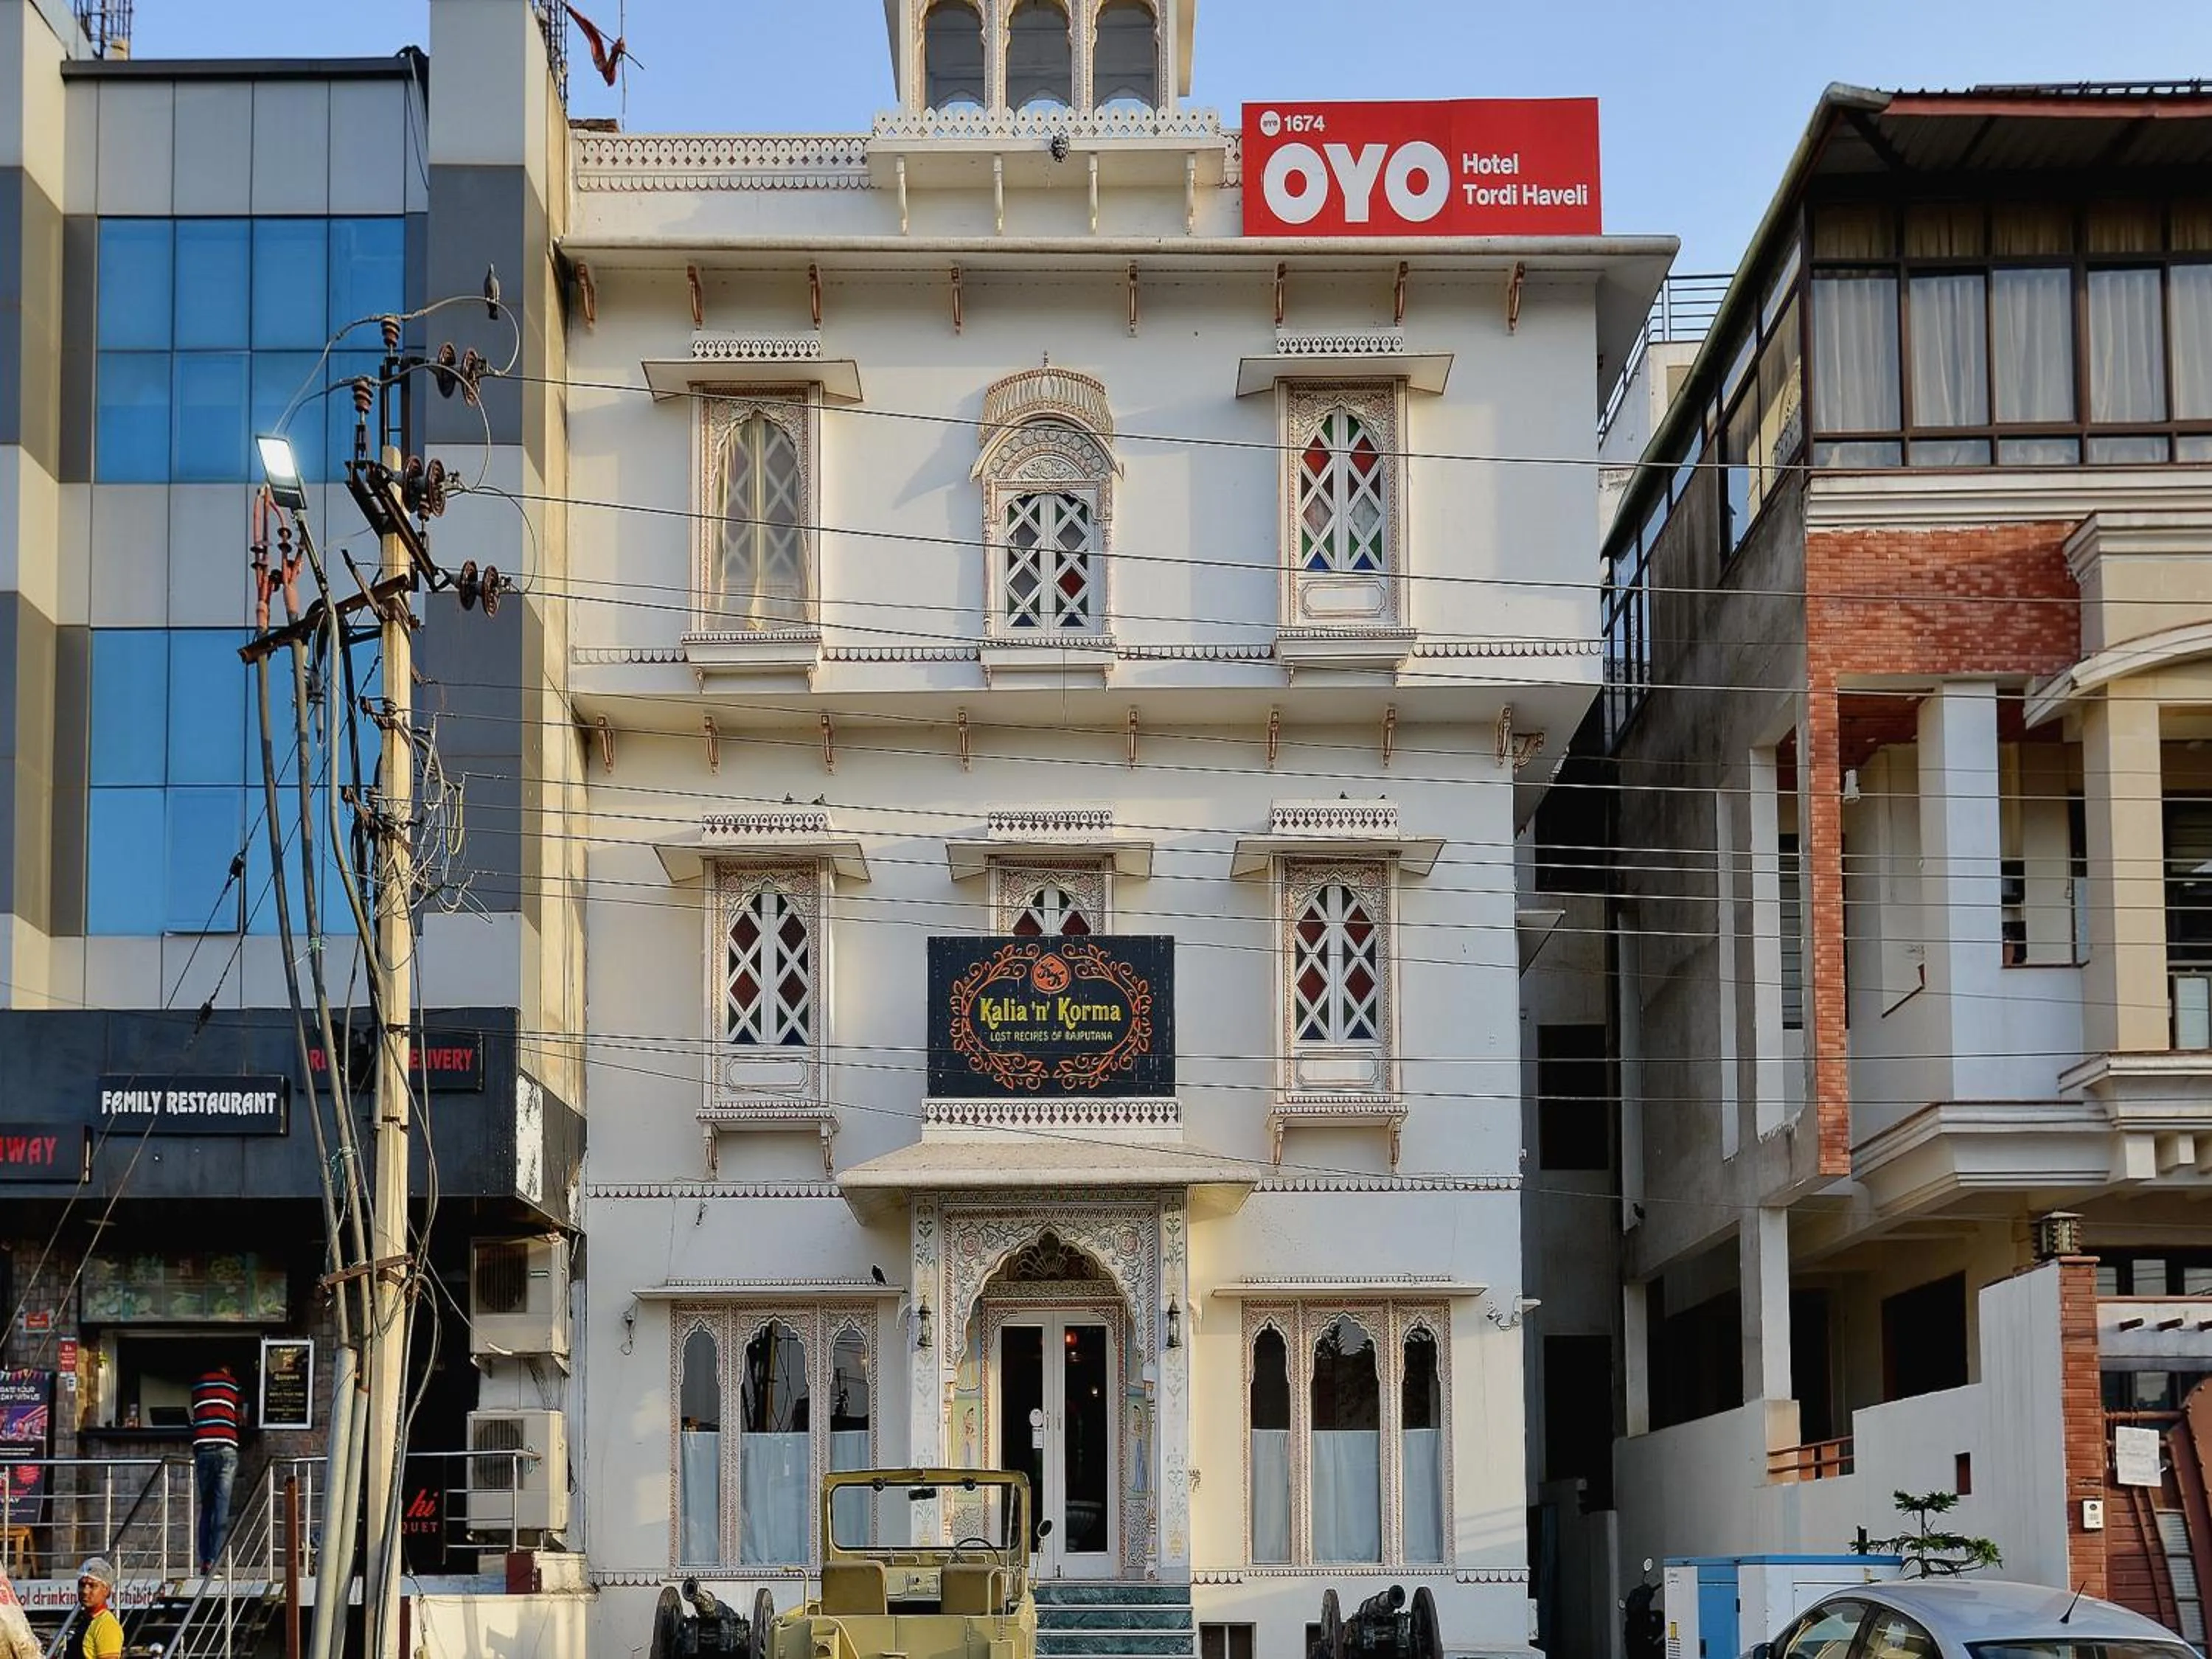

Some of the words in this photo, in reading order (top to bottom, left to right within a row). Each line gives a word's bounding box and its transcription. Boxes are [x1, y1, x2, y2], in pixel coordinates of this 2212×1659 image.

[1284, 114, 1325, 132] 1674
[1462, 153, 1519, 175] Hotel
[1263, 141, 1450, 223] OYO
[1462, 184, 1517, 206] Tordi
[1522, 184, 1588, 206] Haveli
[980, 997, 1028, 1030] Kalia
[1057, 997, 1121, 1030] Korma
[990, 1032, 1011, 1042] LOST
[1015, 1032, 1048, 1042] RECIPES
[101, 1091, 162, 1115] FAMILY
[166, 1091, 276, 1115] RESTAURANT
[0, 1136, 57, 1165] WAY
[33, 1586, 77, 1605] drinkin
